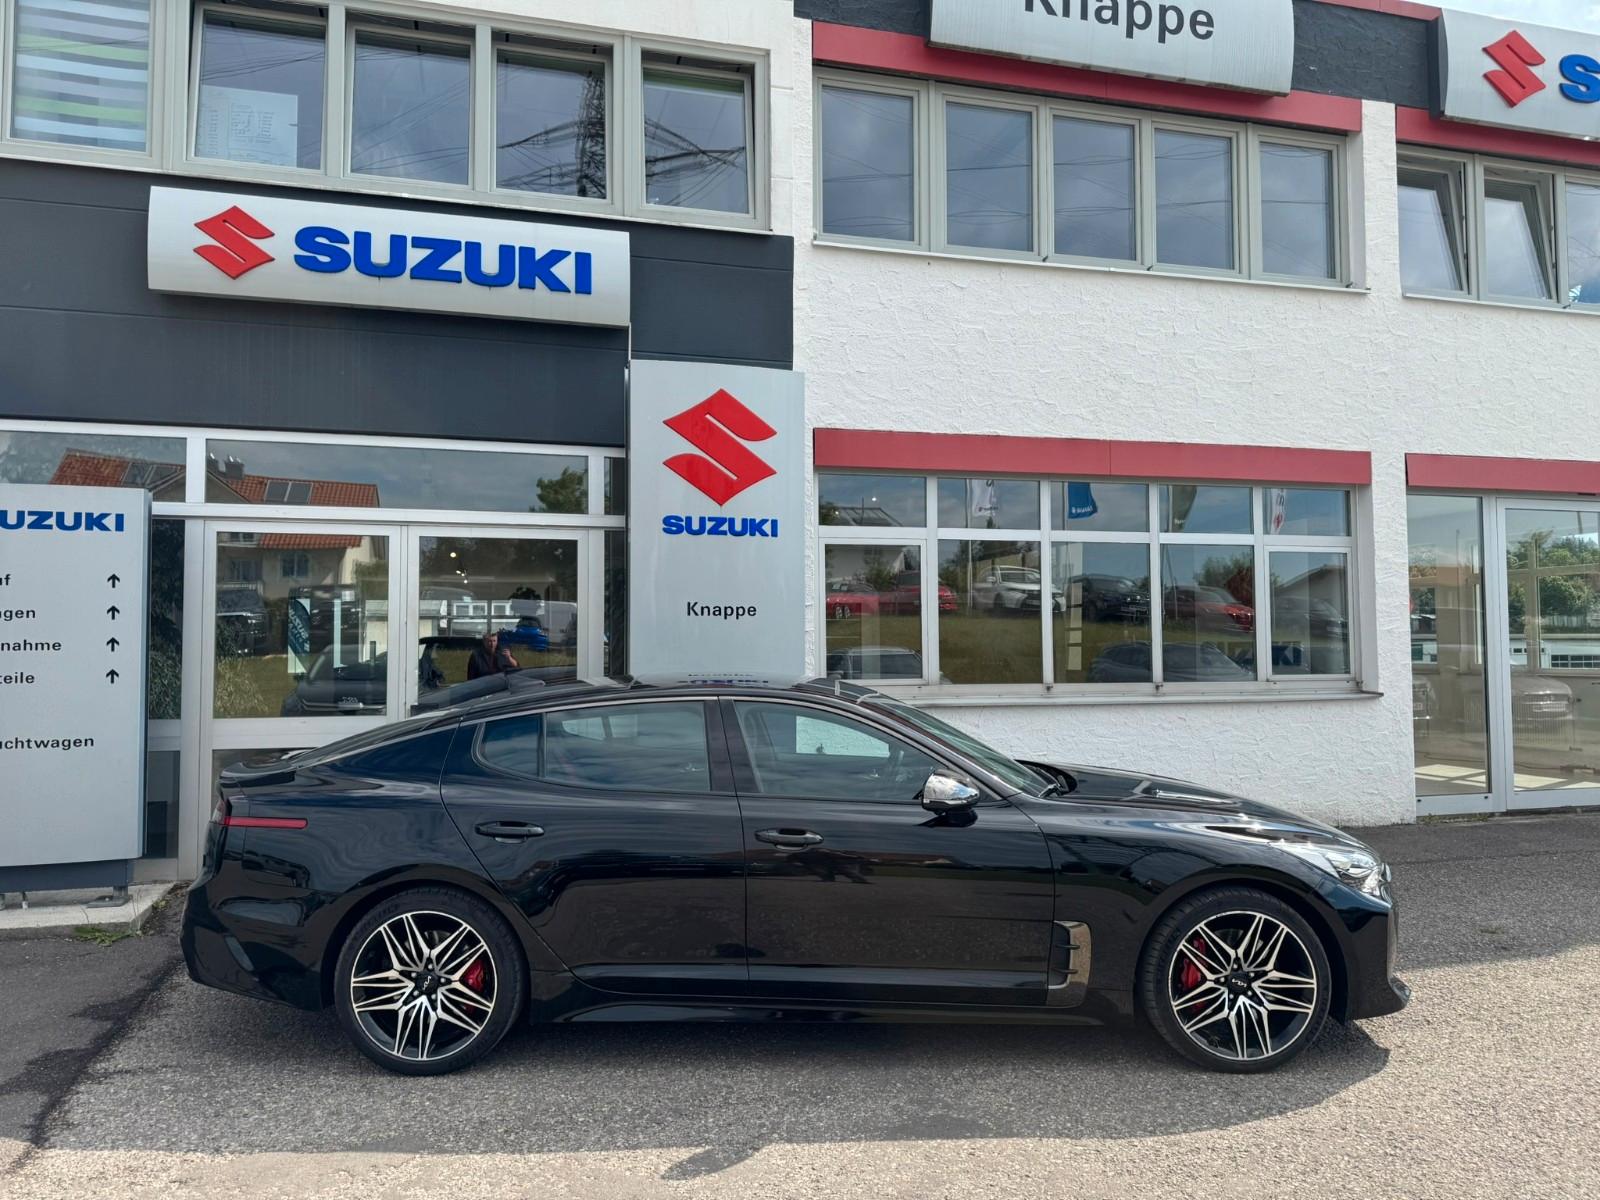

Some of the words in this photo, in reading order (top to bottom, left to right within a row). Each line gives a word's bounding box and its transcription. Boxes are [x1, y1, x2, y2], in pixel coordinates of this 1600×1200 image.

[294, 226, 592, 294] SUZUKI
[662, 515, 778, 537] SUZUKI
[0, 609, 36, 621] gen
[687, 601, 757, 620] Knappe
[0, 639, 62, 651] nahme
[0, 737, 94, 750] chtwagen
